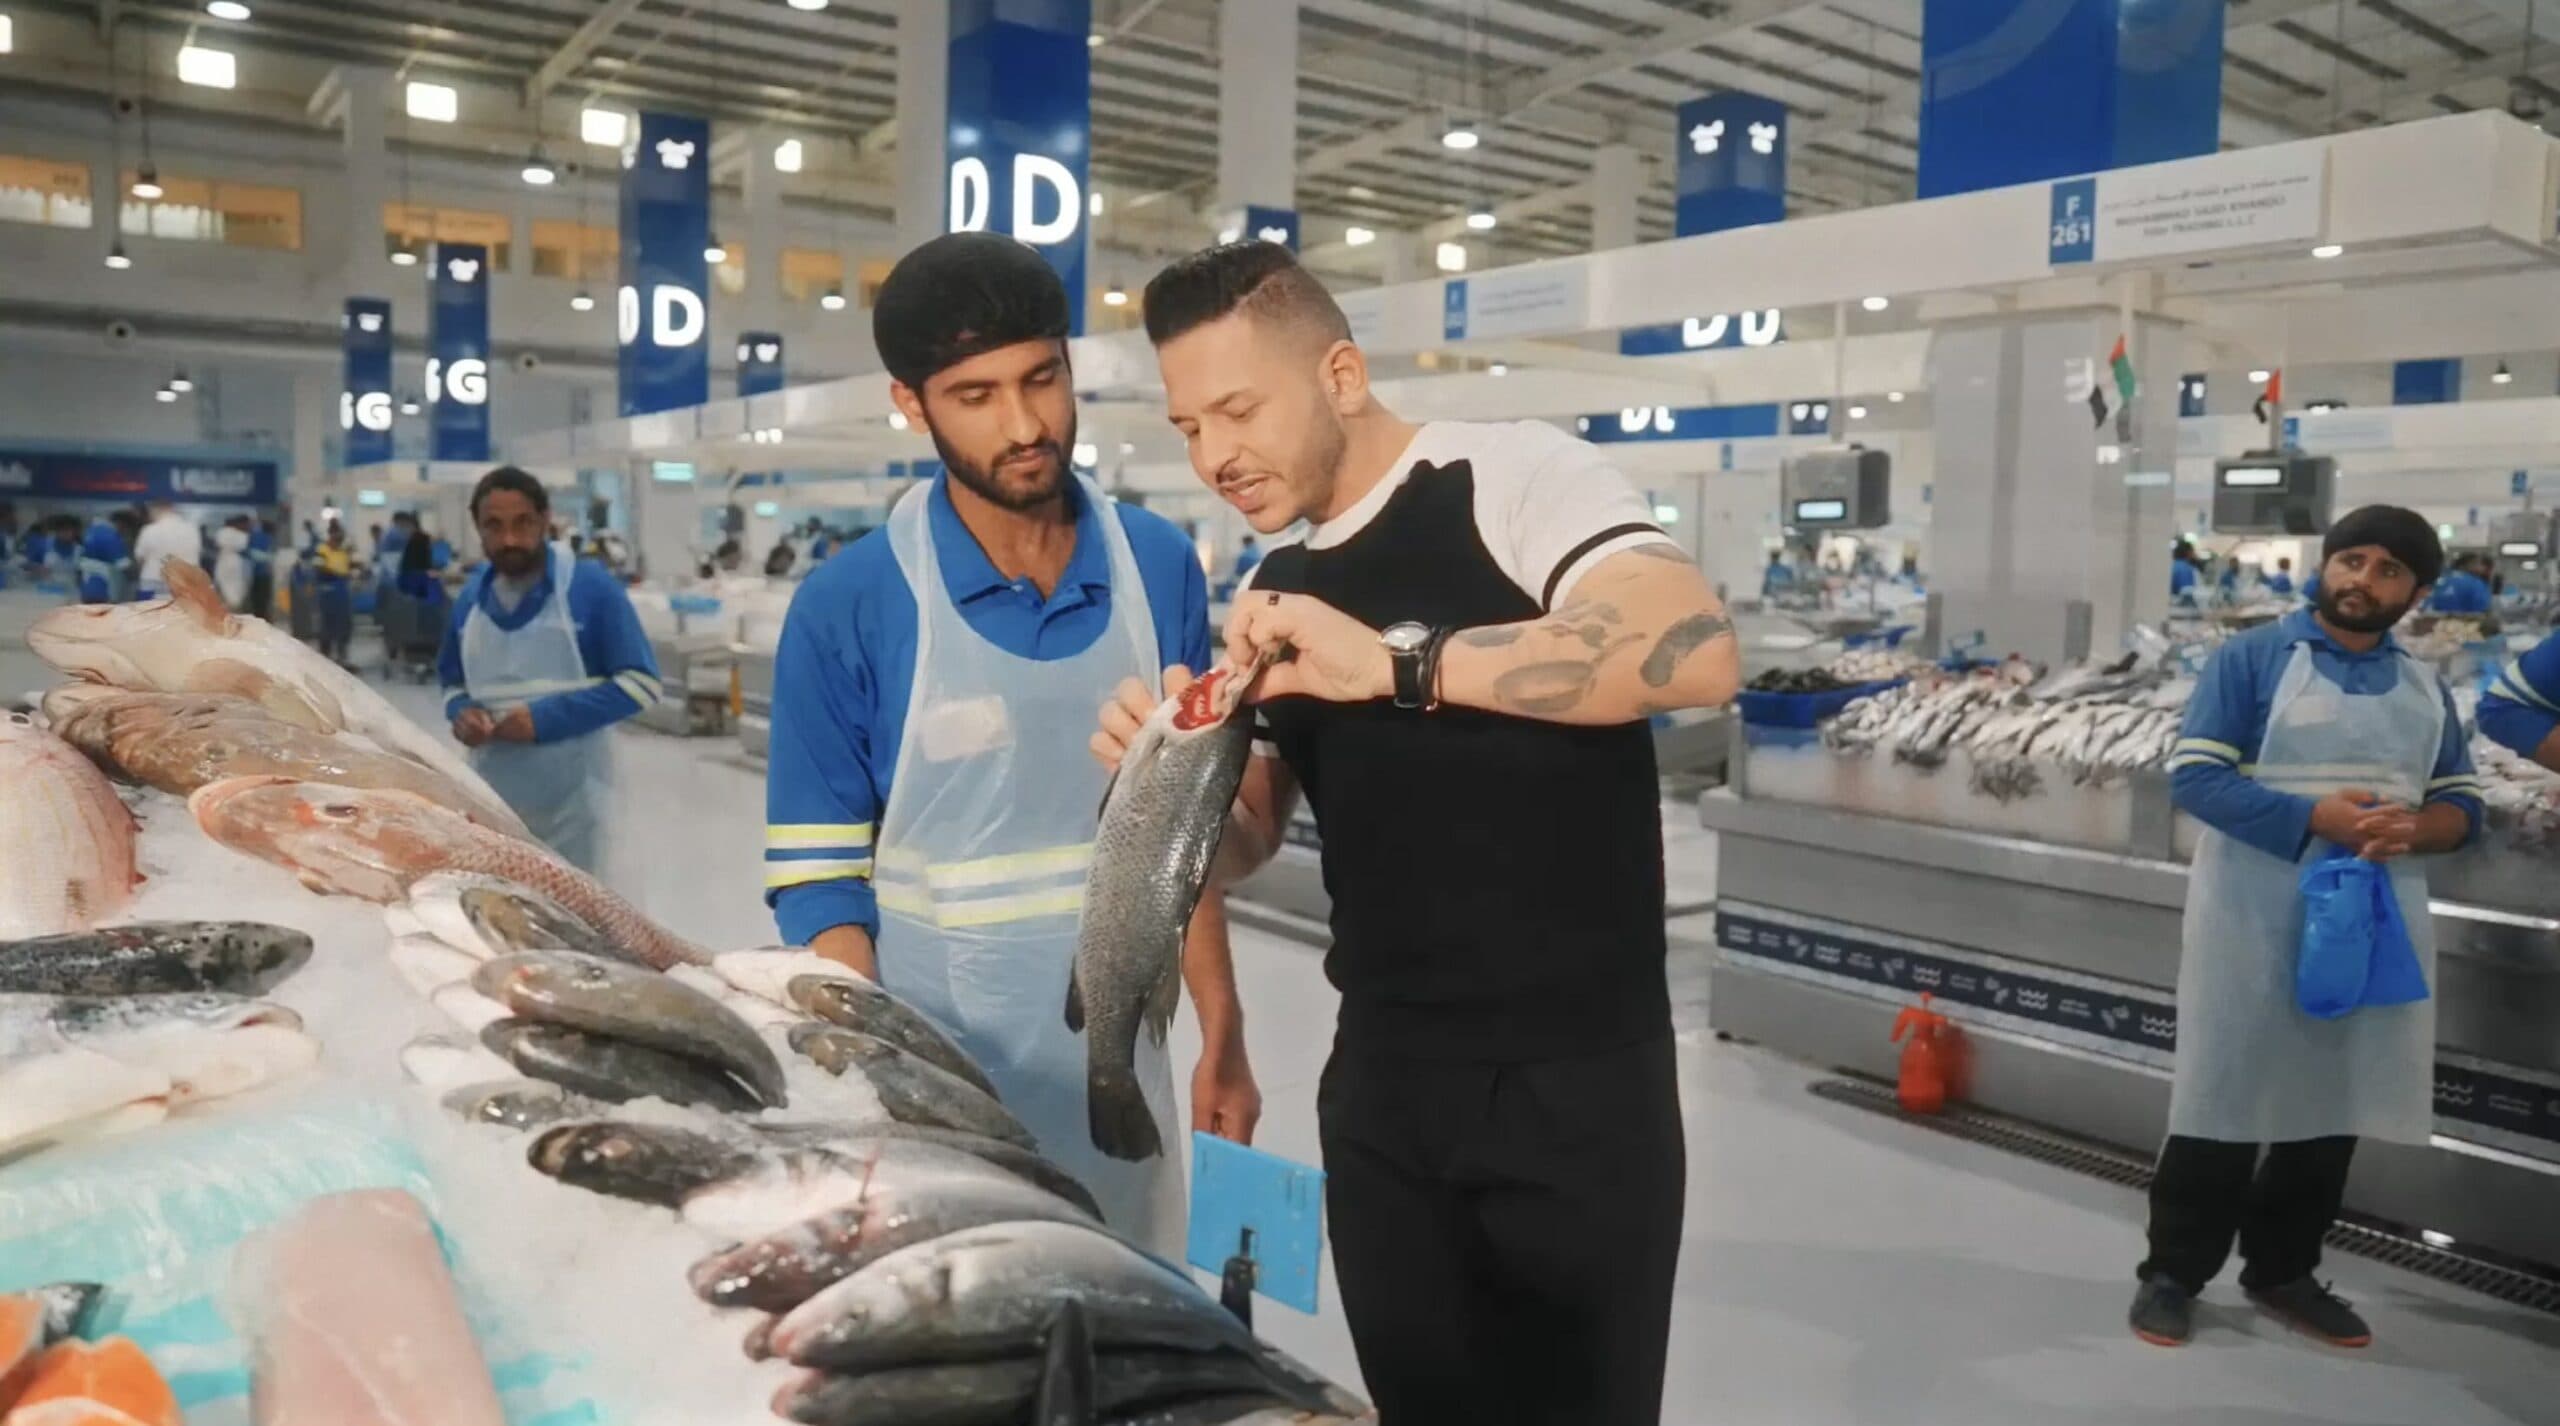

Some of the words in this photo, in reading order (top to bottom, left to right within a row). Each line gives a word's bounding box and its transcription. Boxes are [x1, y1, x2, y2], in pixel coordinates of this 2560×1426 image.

[1013, 153, 1080, 245] D
[2065, 195, 2080, 217] F
[2052, 223, 2091, 247] 261
[653, 284, 704, 346] D
[446, 358, 488, 404] G
[356, 391, 392, 430] G
